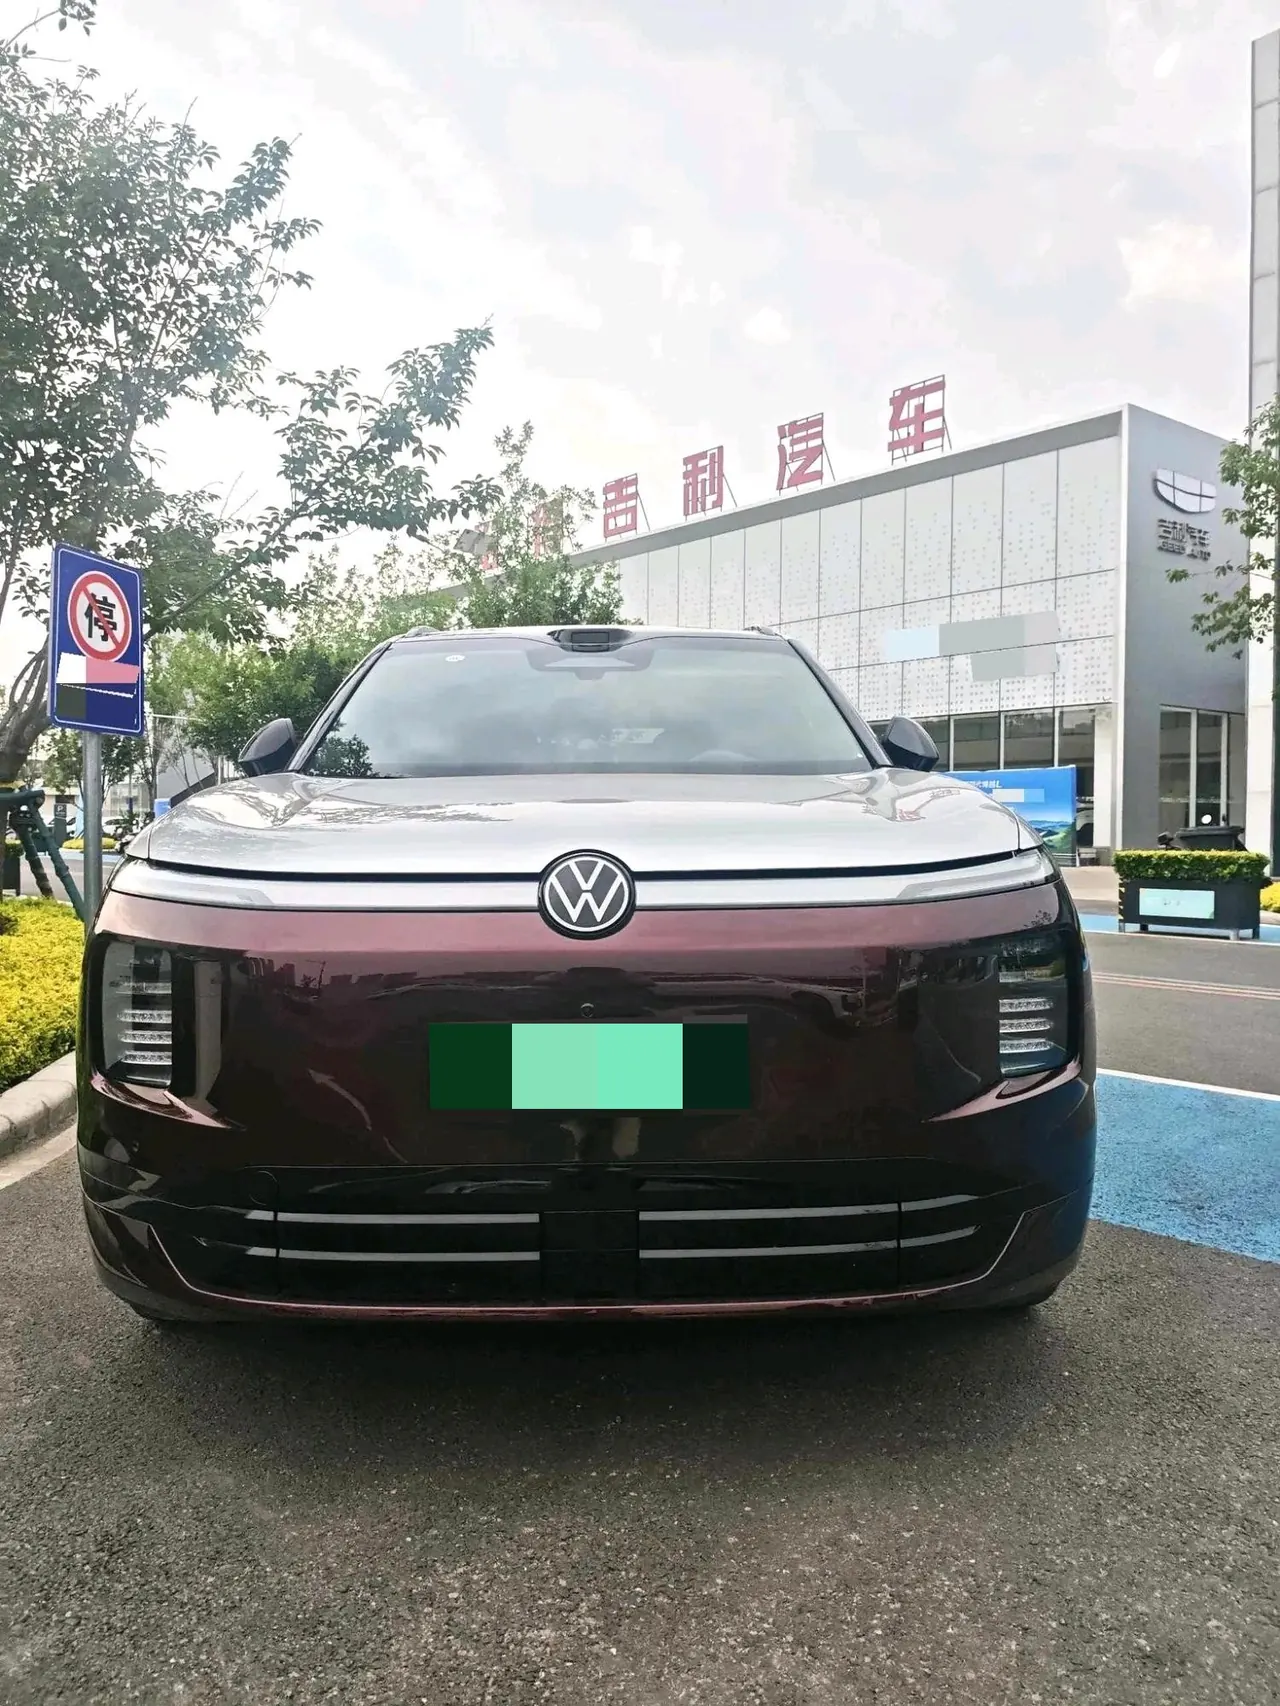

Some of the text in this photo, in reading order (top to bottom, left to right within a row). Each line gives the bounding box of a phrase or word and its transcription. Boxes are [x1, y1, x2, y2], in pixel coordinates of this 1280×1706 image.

[602, 376, 946, 538] 吉利汽车
[84, 592, 117, 642] 停
